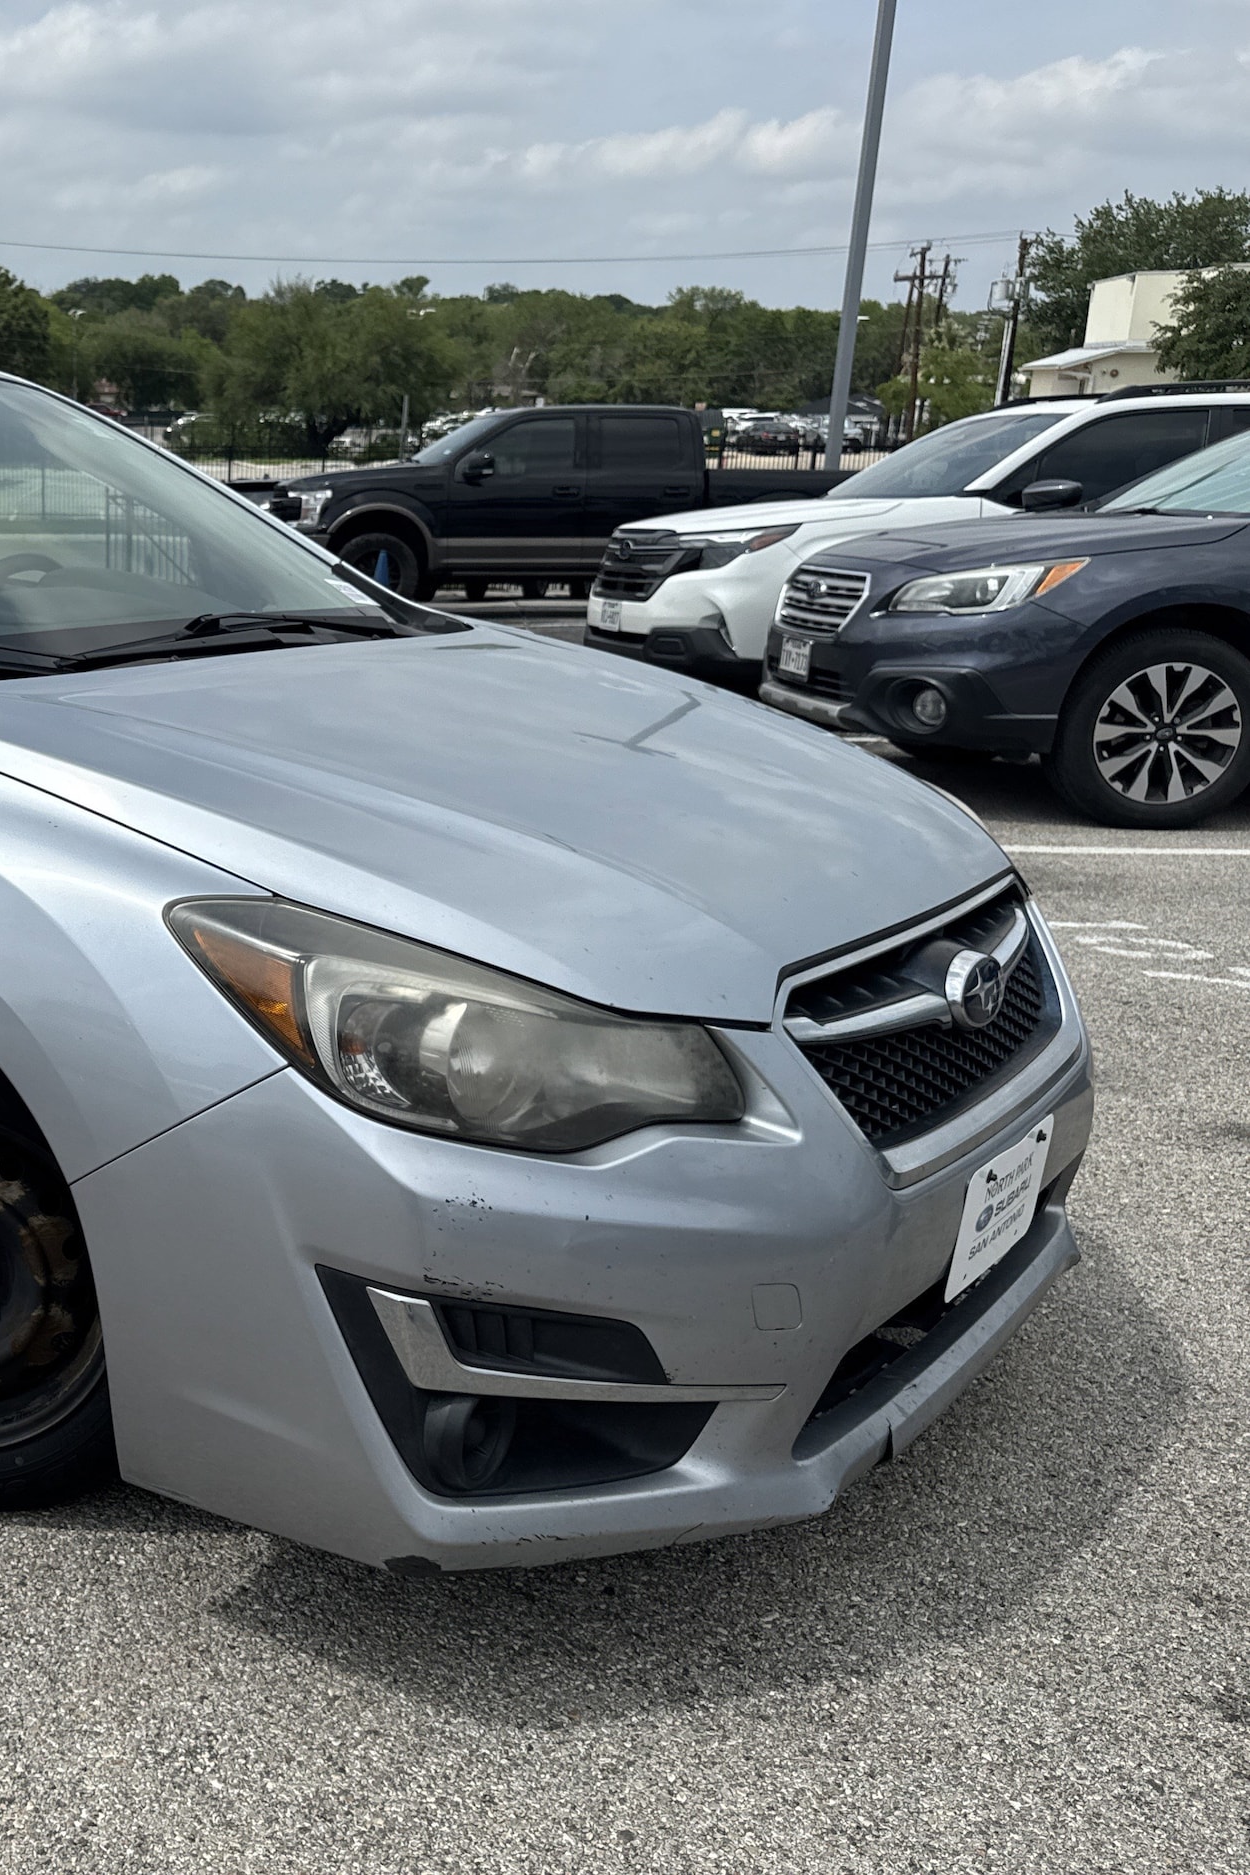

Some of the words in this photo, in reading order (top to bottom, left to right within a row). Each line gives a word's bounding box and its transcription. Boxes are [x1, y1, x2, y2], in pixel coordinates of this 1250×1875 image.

[983, 1168, 1016, 1204] NORTH
[1014, 1151, 1035, 1182] PARK
[994, 1173, 1032, 1217] SUBARU
[968, 1234, 990, 1260] SAN
[989, 1203, 1025, 1245] ANTONIO
